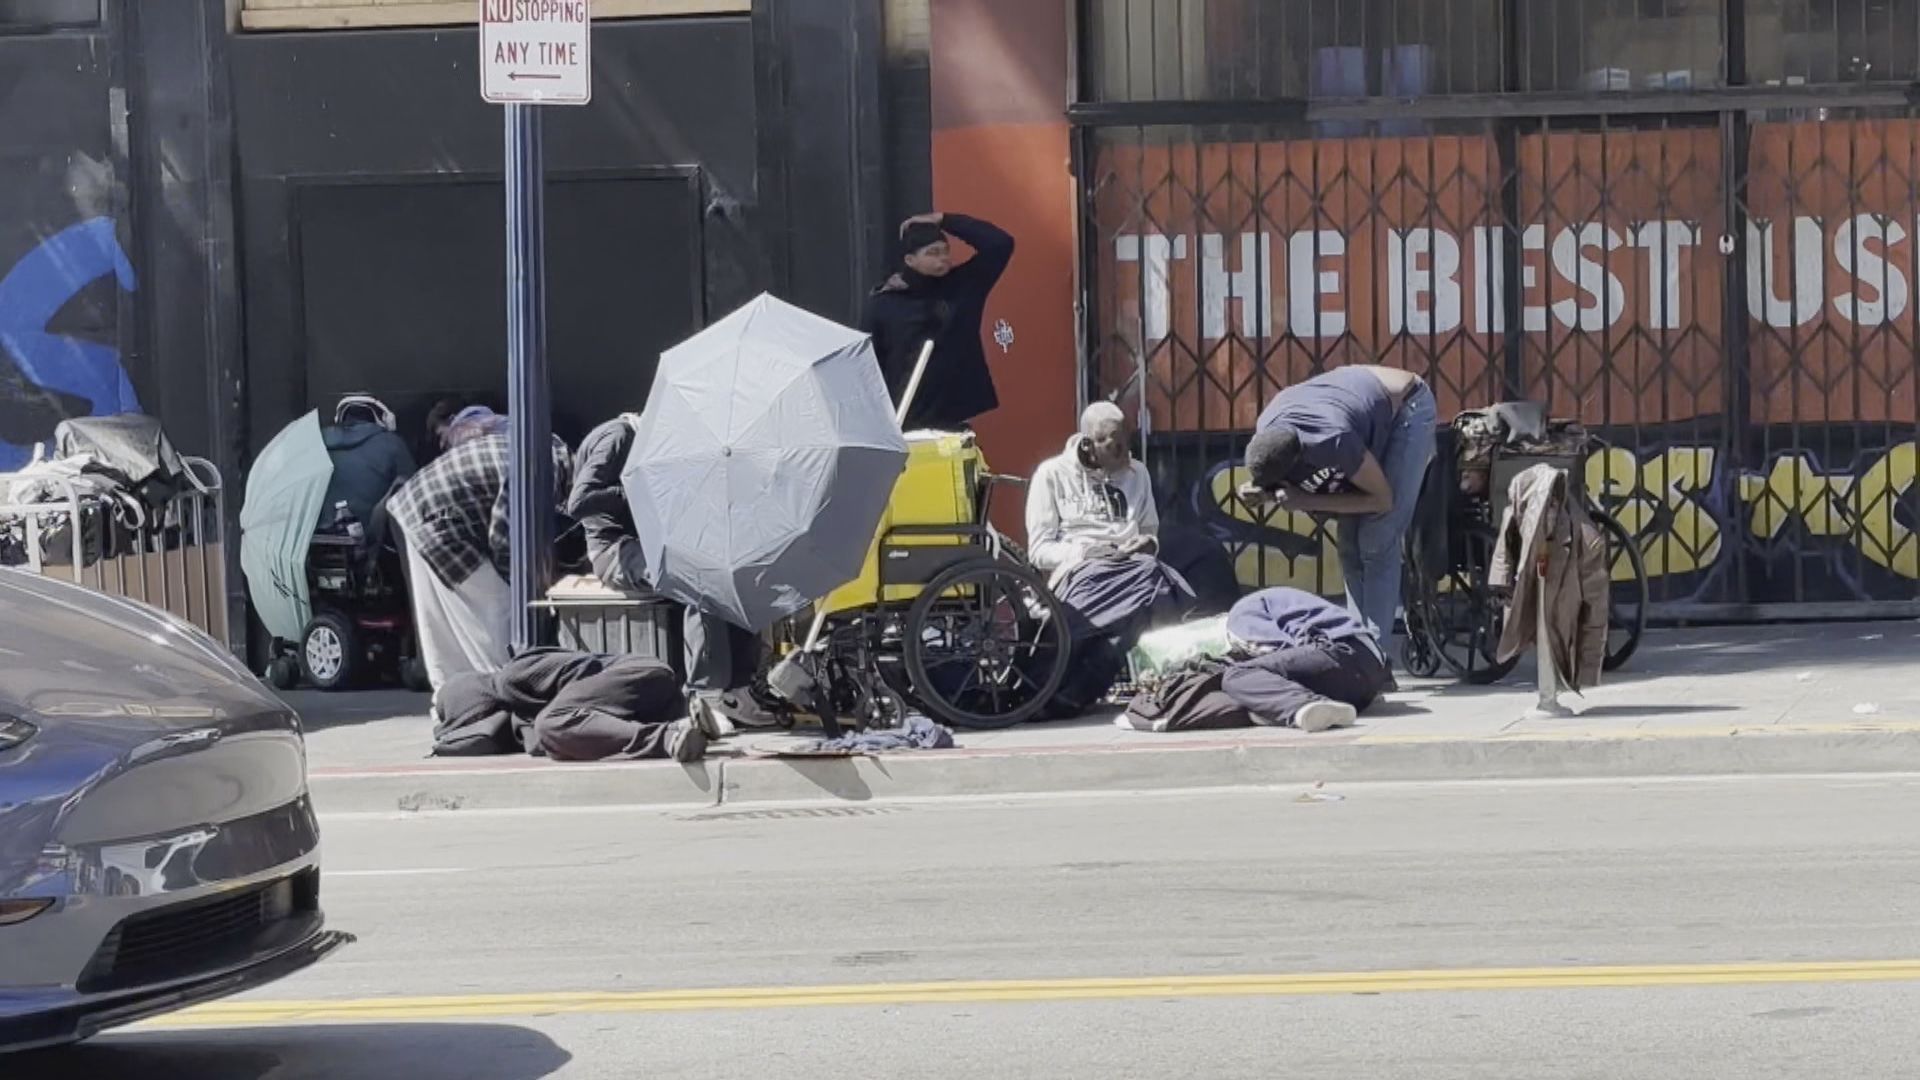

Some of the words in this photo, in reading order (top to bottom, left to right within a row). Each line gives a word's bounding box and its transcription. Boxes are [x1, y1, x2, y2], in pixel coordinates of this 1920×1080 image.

[515, 0, 584, 23] STOPPING
[494, 41, 529, 64] ANY
[539, 42, 578, 65] TIME
[1116, 230, 1346, 339] THE
[1388, 220, 1701, 335] BEST
[1746, 213, 1920, 328] US
